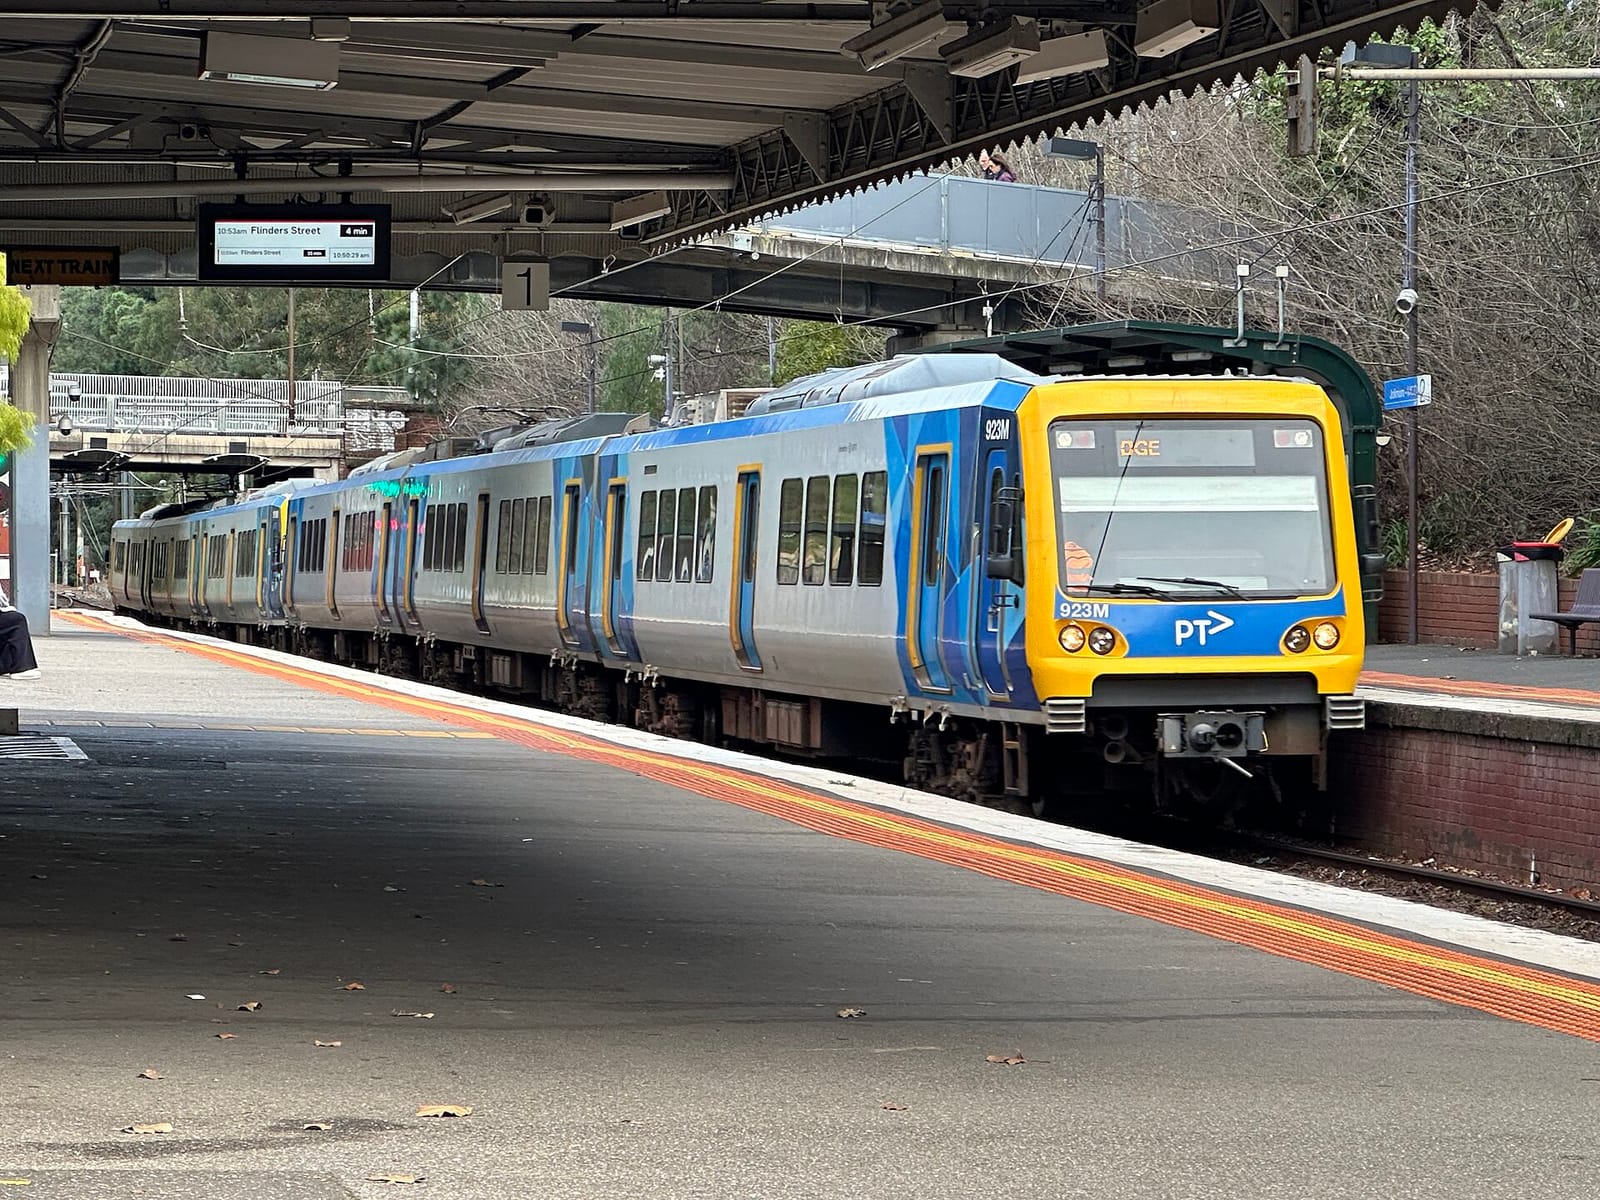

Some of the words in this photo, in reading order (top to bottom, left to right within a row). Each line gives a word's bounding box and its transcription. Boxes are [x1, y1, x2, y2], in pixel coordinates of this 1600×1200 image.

[218, 227, 247, 235] 10:53am
[250, 226, 289, 235] Flinders
[290, 226, 321, 235] Street
[345, 227, 352, 235] 4
[353, 227, 368, 235] min
[10, 259, 54, 275] NEXT
[56, 259, 114, 275] TRAIN
[516, 267, 531, 306] 1
[985, 419, 1010, 441] 923M
[1059, 603, 1110, 618] 923M
